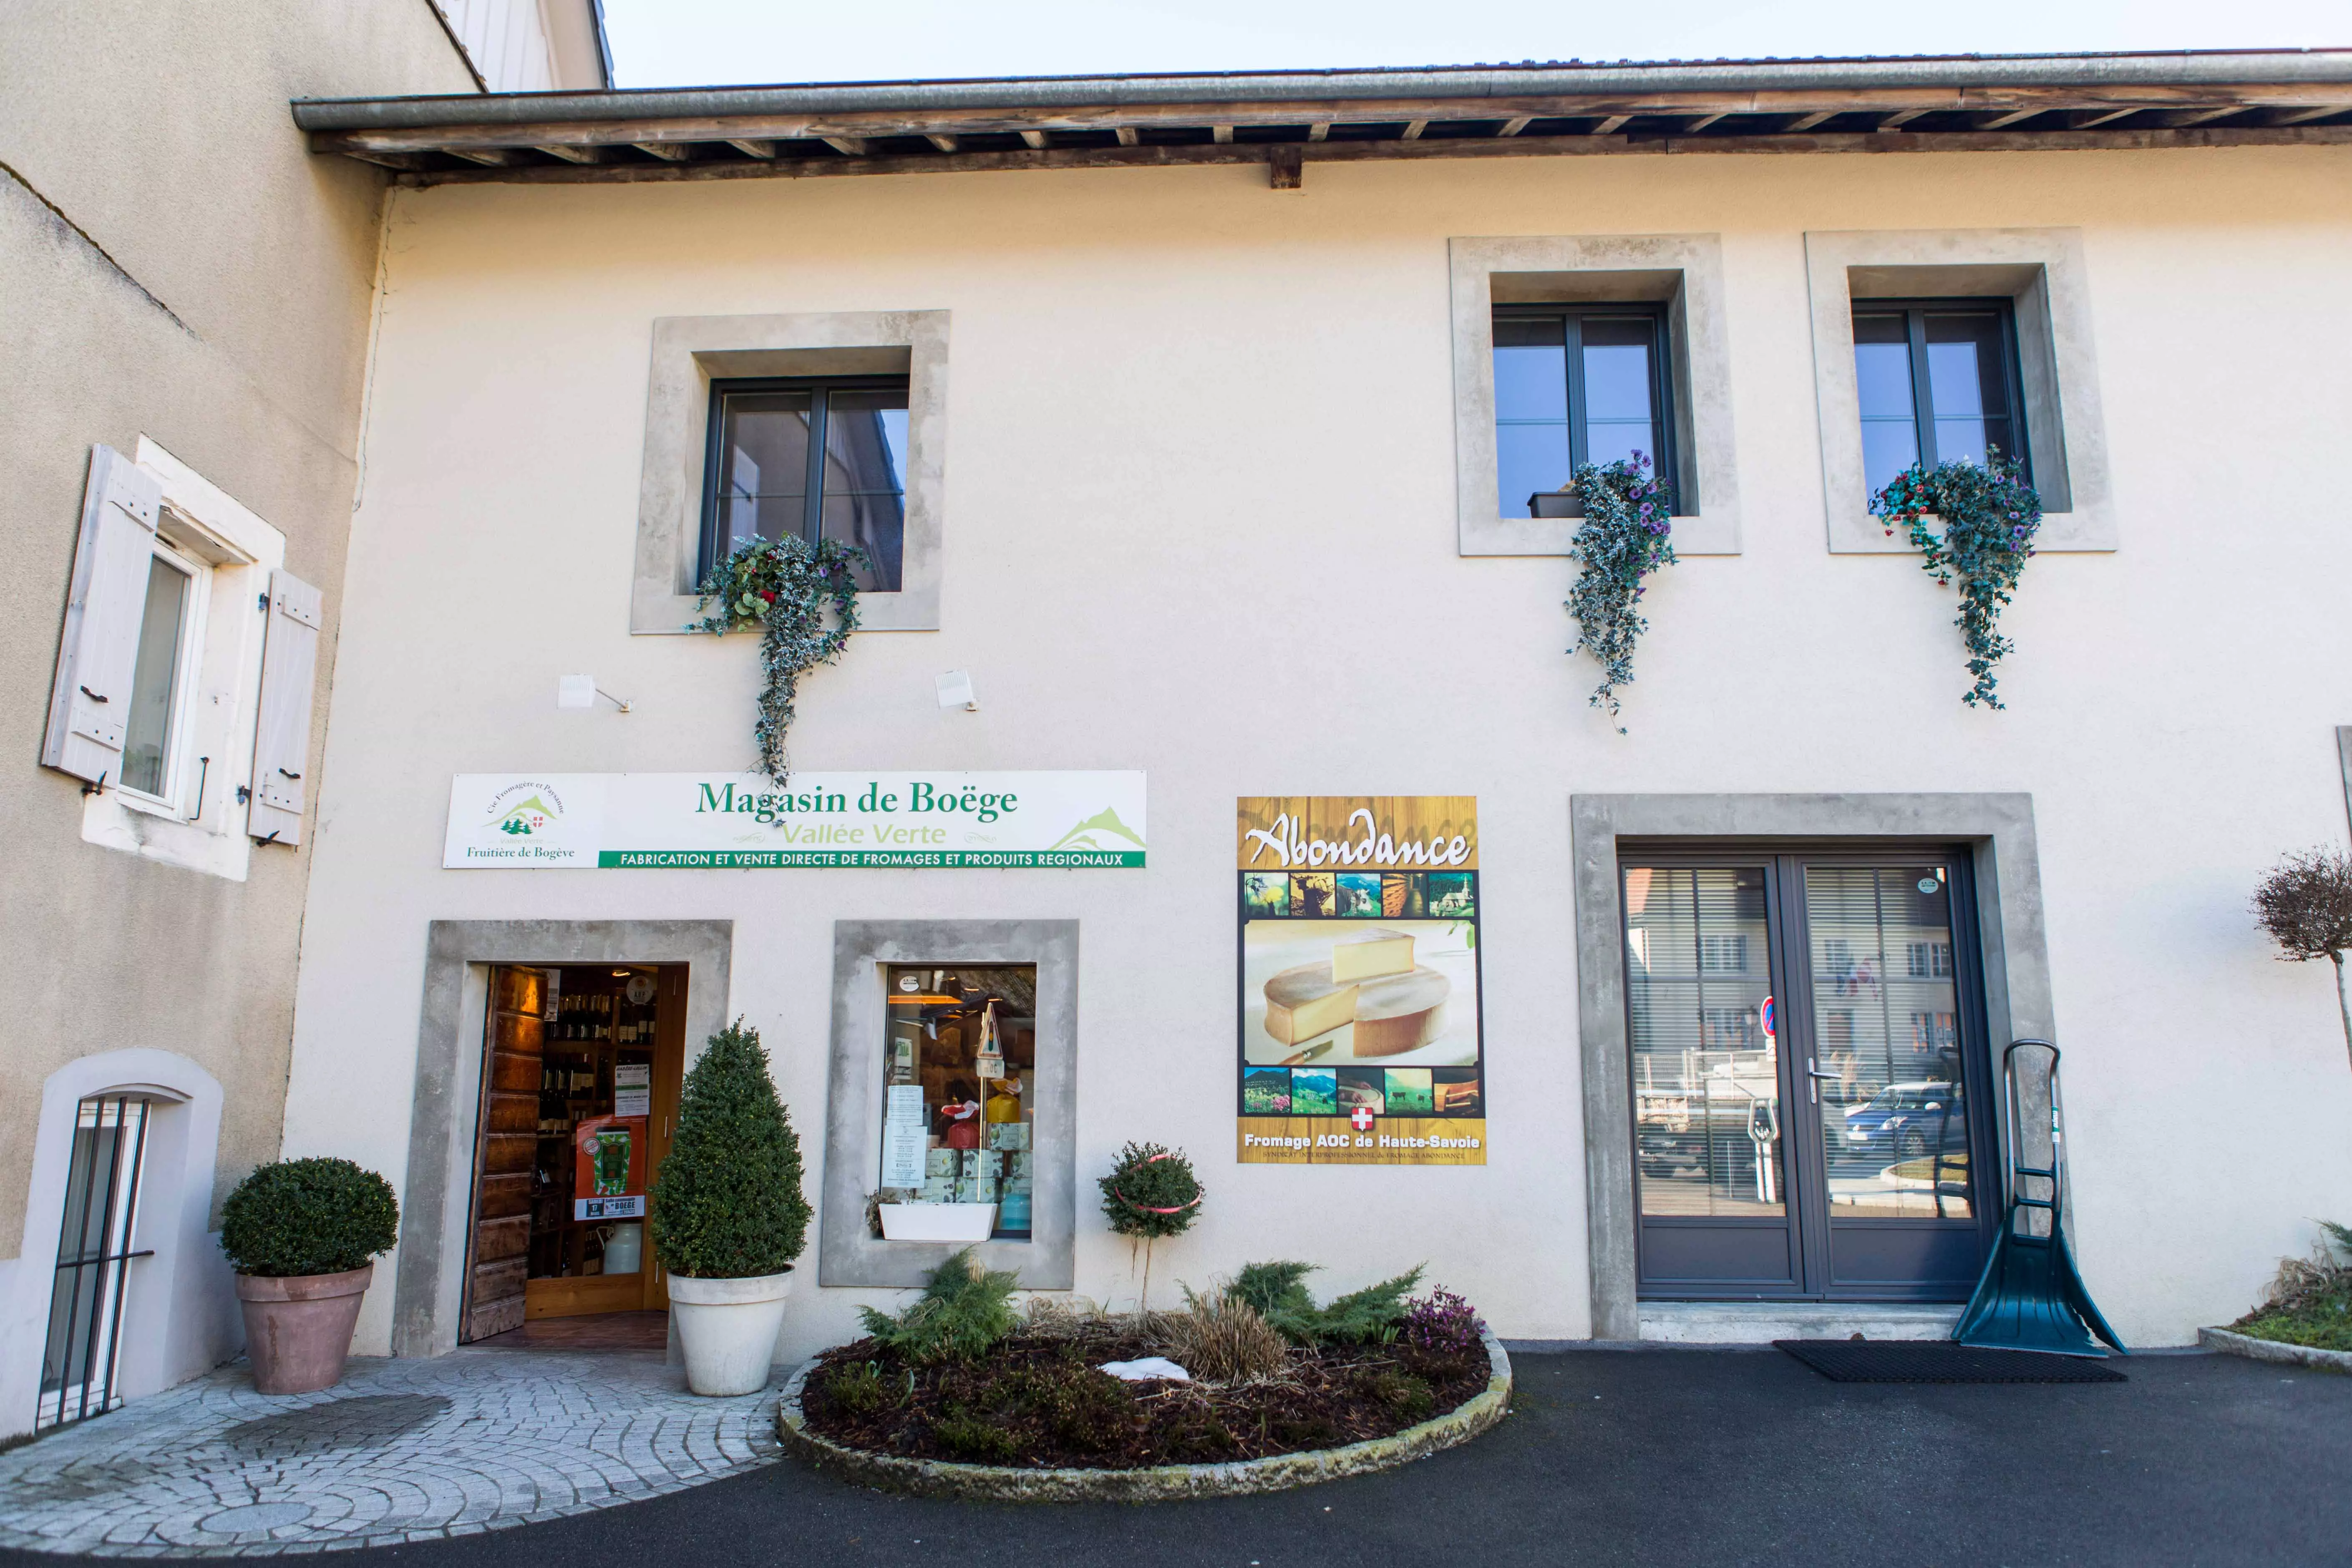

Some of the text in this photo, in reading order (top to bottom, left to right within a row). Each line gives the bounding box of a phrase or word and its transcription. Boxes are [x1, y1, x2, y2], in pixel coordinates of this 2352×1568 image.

[487, 801, 497, 813] Cie
[495, 781, 534, 800] Fromagère
[544, 784, 564, 814] Paysanne
[695, 782, 1017, 823] Magasin de Boëge
[782, 824, 947, 844] Vallée Verte
[1245, 808, 1471, 867] Abondance
[467, 847, 574, 860] Fruitière de Bogève
[621, 854, 1123, 865] FABRICATION ET VENTE DIRECTE DE FROMAGES ET PRODUITS REGIONAUX
[1244, 1134, 1480, 1150] Fromage AOC de Haute-Savoie
